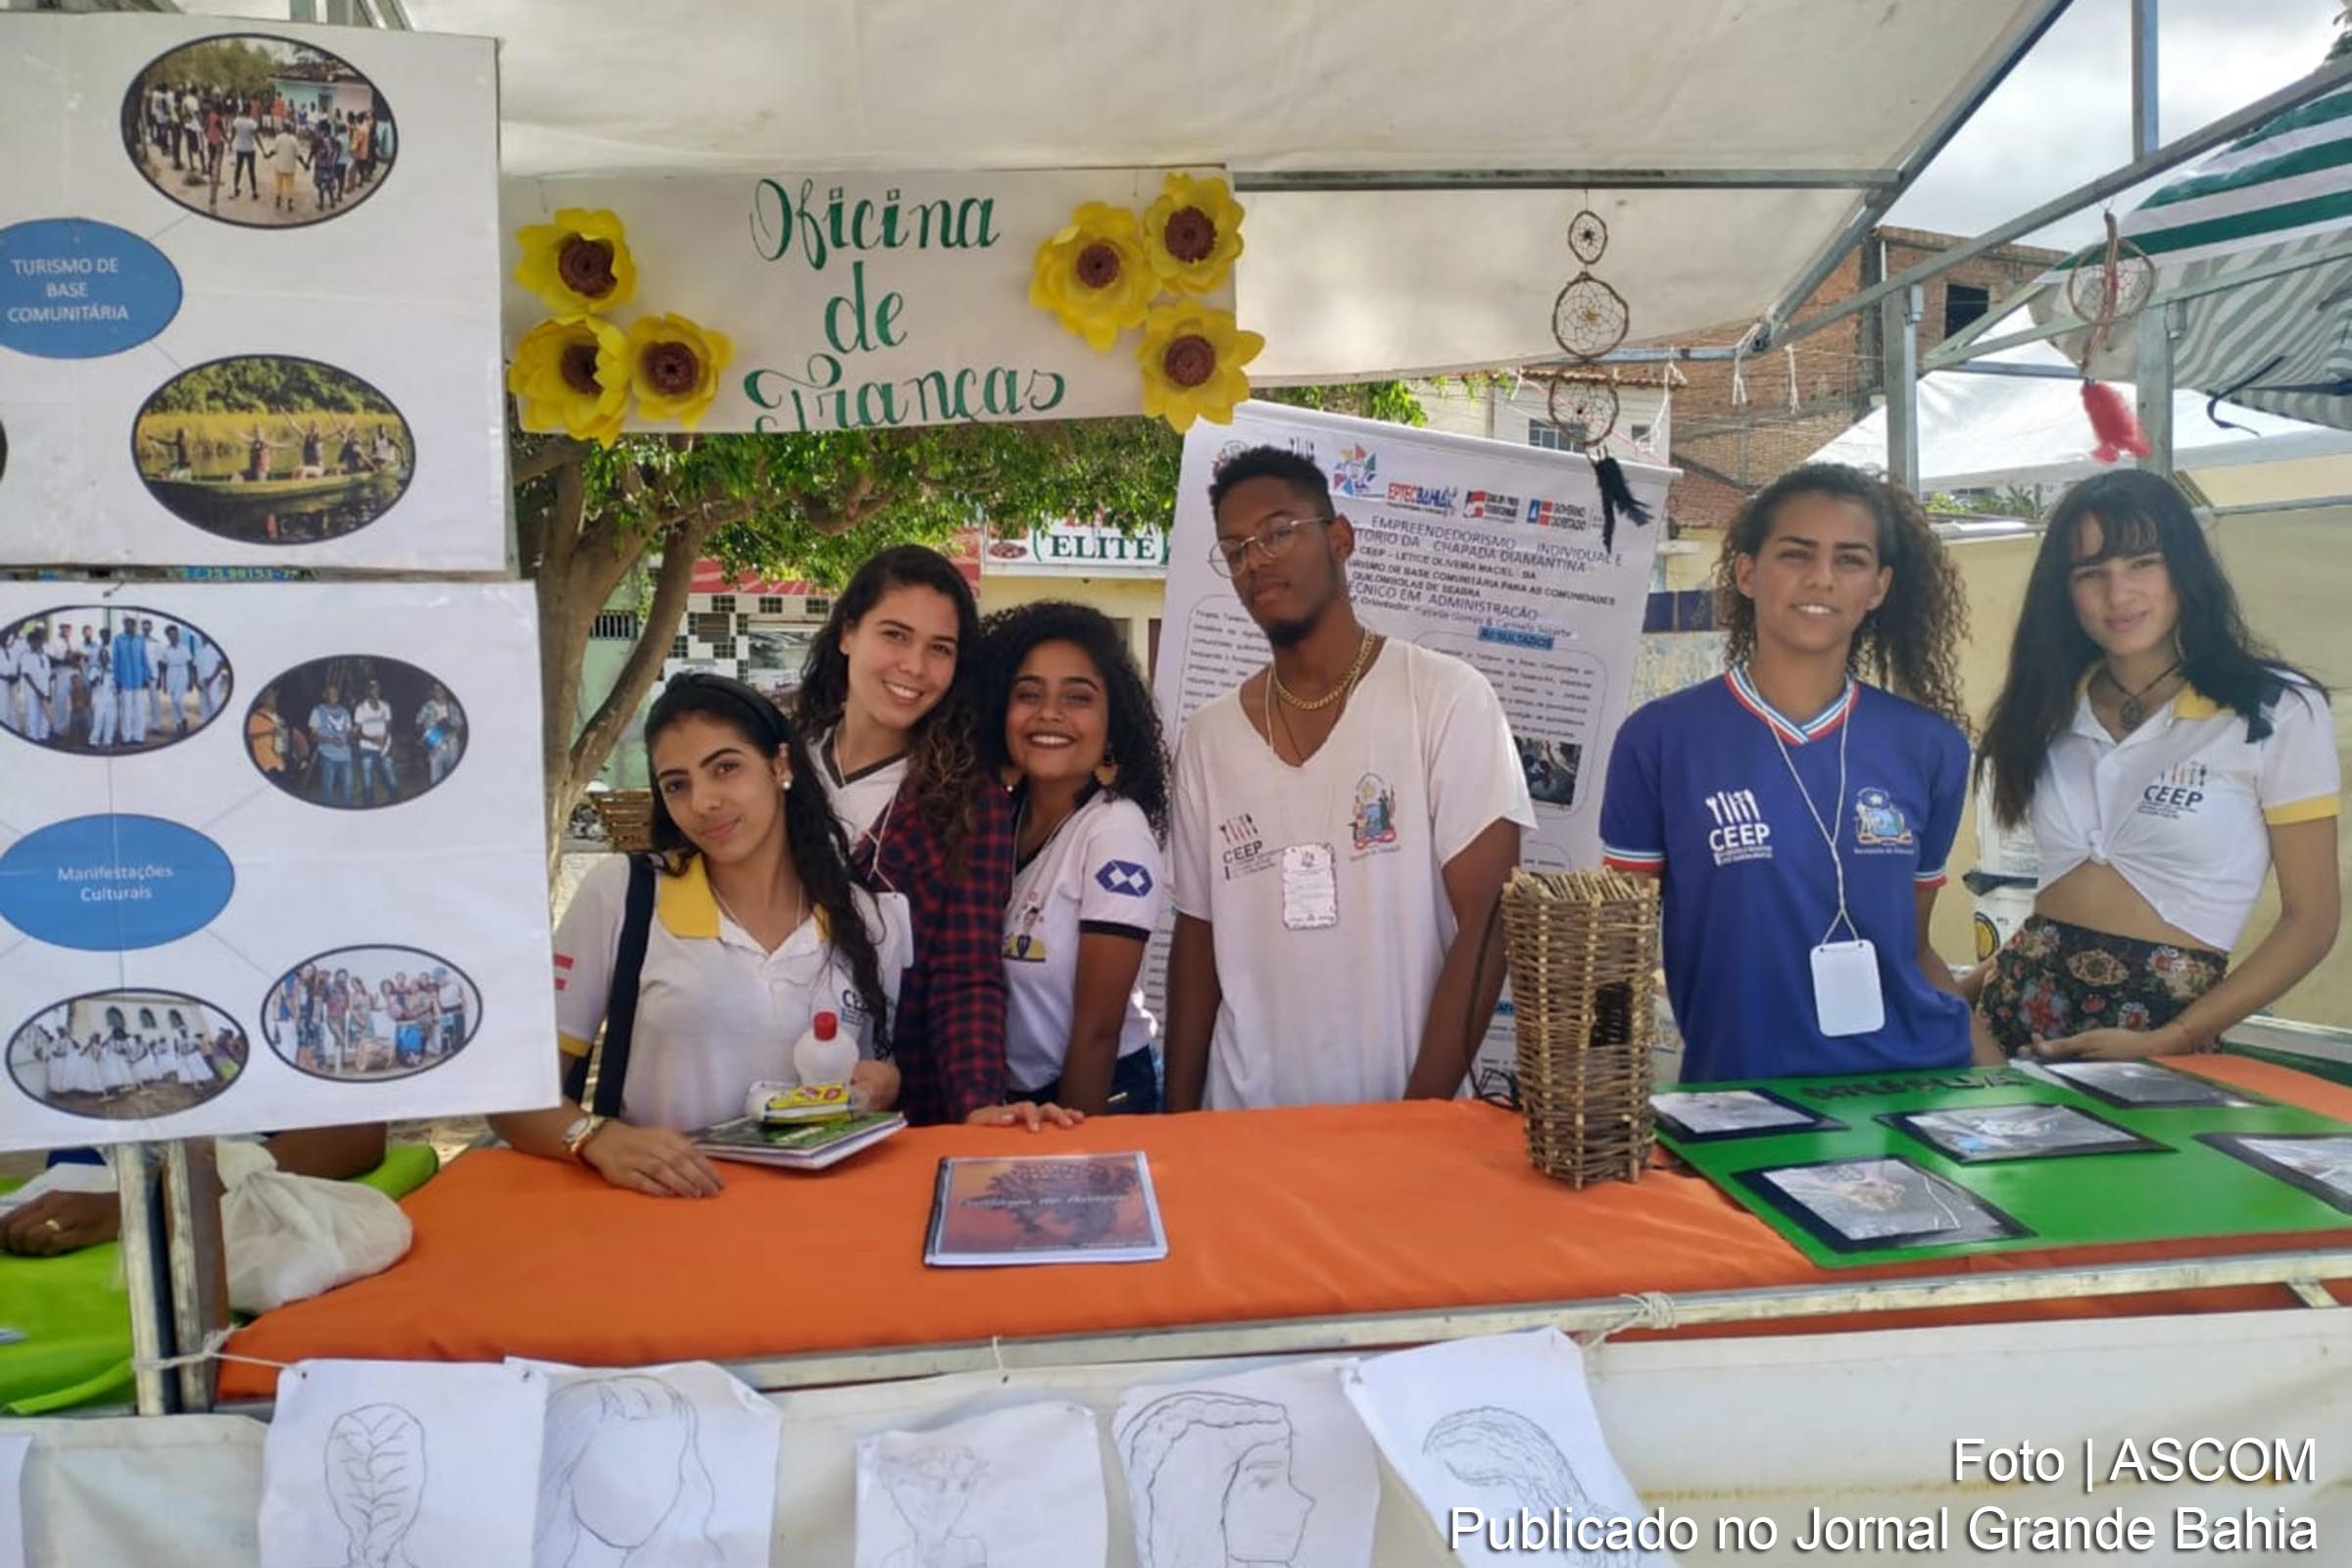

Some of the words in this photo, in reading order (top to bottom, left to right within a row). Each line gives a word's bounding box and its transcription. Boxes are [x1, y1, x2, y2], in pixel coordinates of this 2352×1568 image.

[749, 177, 1001, 270] Oficina
[13, 258, 92, 275] TURISMO
[97, 258, 119, 273] DE
[46, 281, 89, 298] BASE
[7, 303, 129, 323] COMUNITÁRIA
[824, 261, 907, 354] de
[1372, 514, 1516, 551] EMPREENDEDORISMO
[1401, 534, 1420, 547] DA
[1433, 540, 1496, 559] CHAPADA
[1500, 549, 1586, 572] DIAMANTINA
[1478, 564, 1514, 577] MACIEL
[1400, 588, 1421, 601] EM
[1403, 566, 1430, 578] BASE
[1433, 570, 1499, 589] COMUNITÁRIA
[1501, 580, 1527, 593] PARA
[1544, 587, 1615, 606] COMUNIDADES
[2143, 785, 2203, 807] CEEP
[1708, 823, 1771, 852] CEEP
[1223, 840, 1264, 864] CEEP
[57, 863, 174, 882] Manifestações
[80, 886, 152, 903] Culturais
